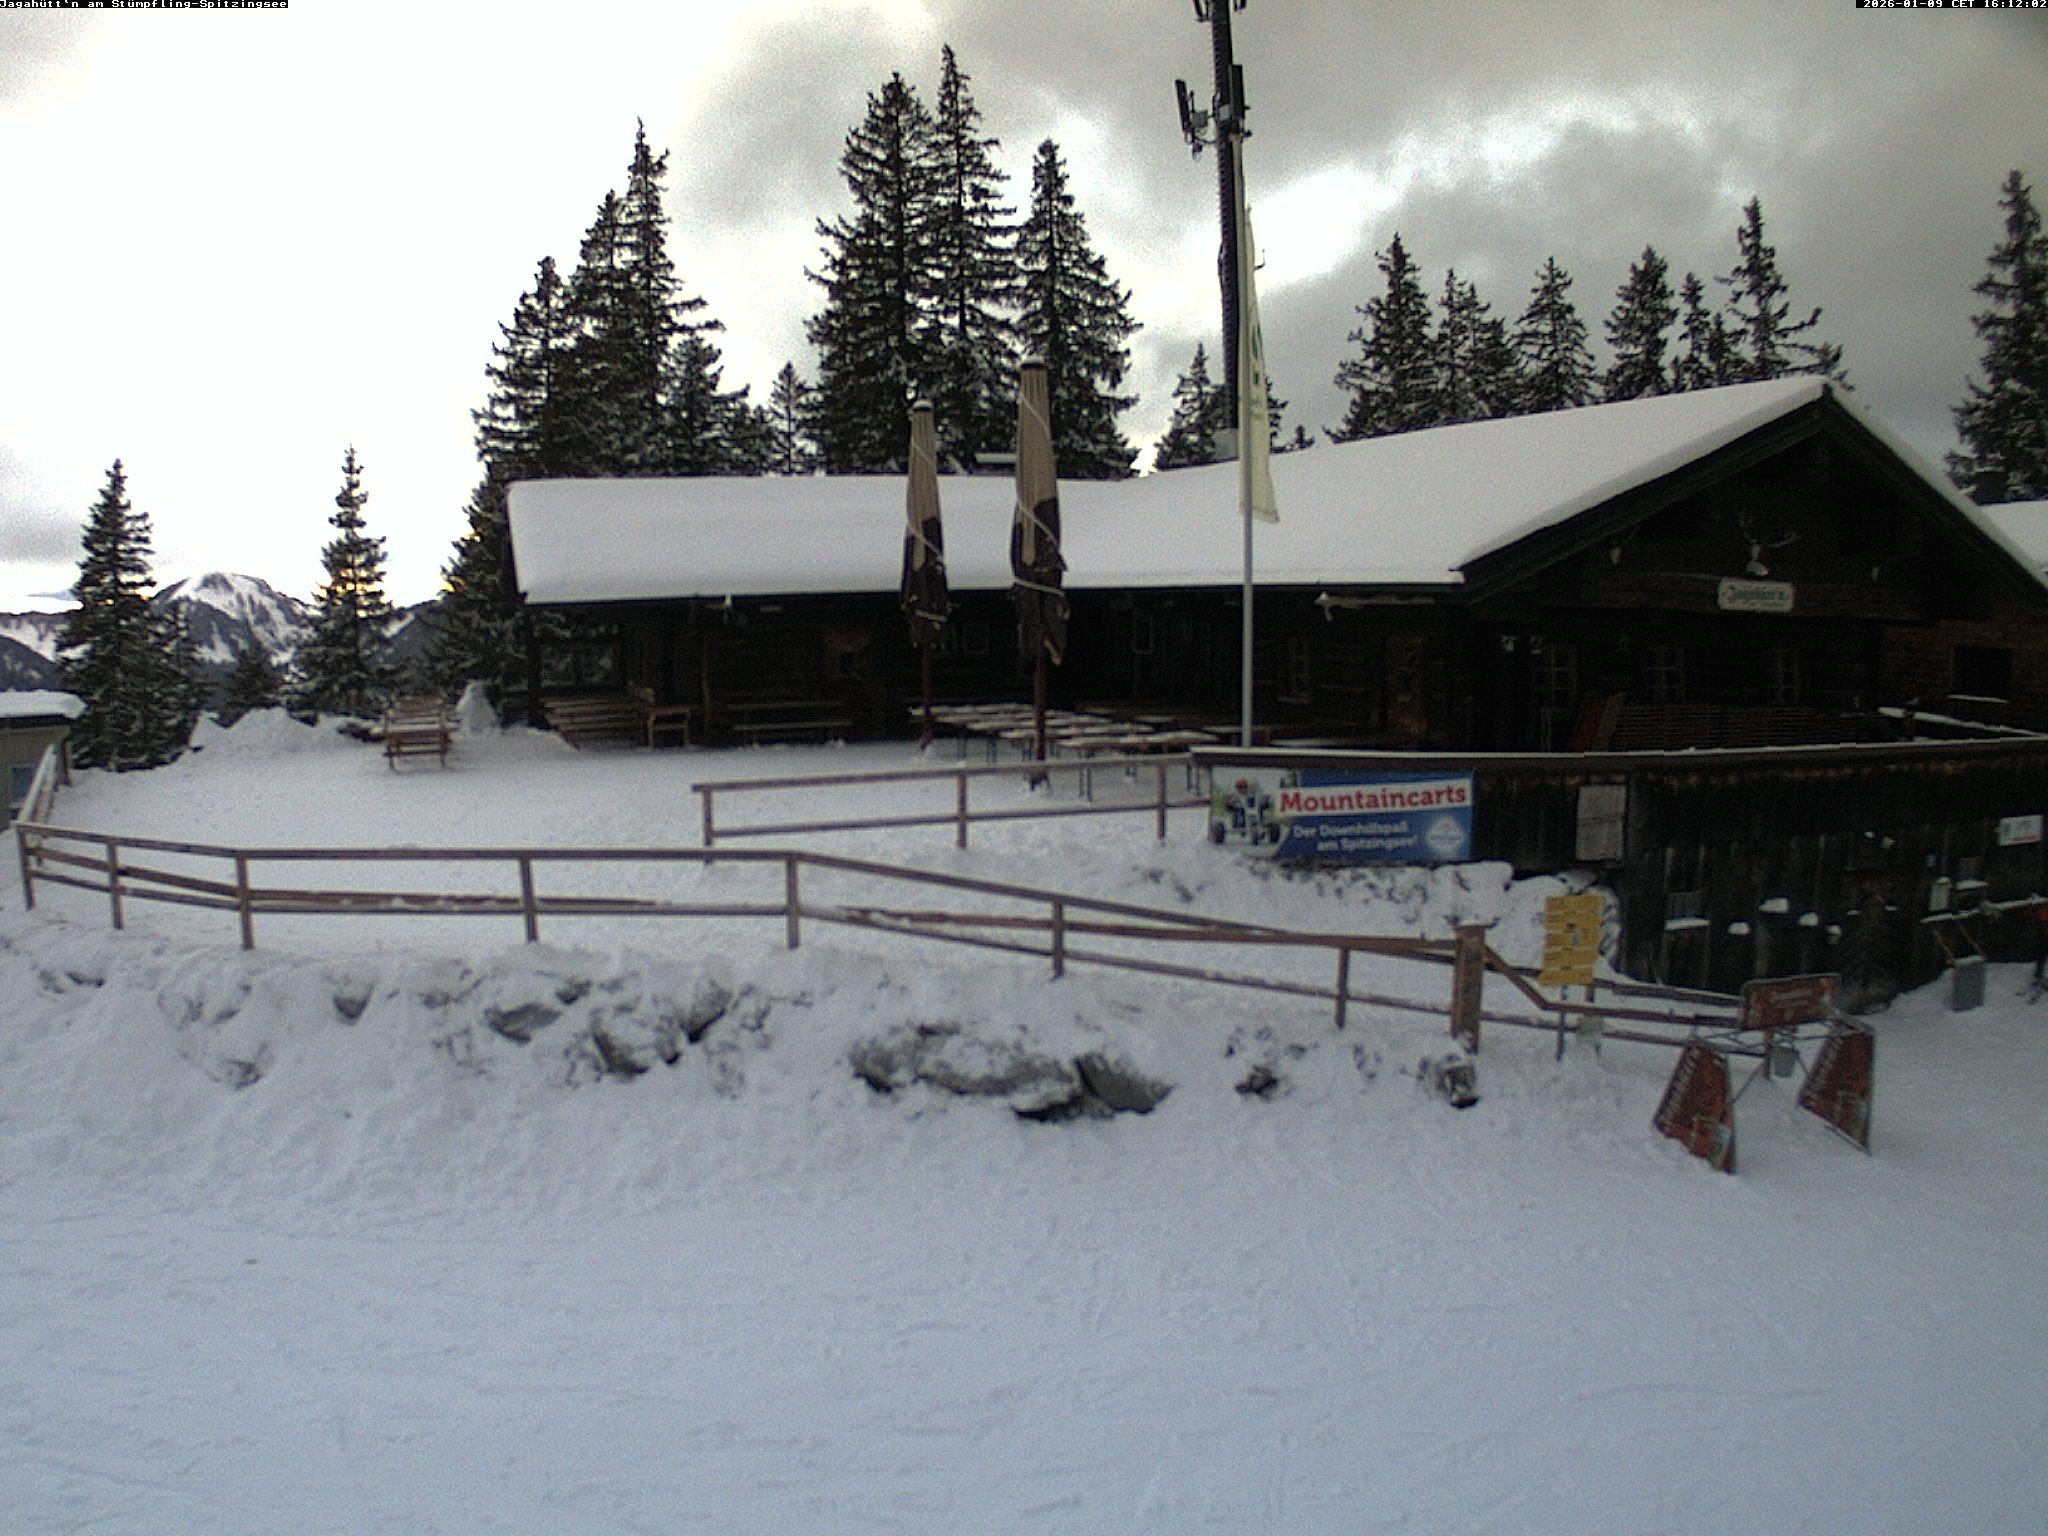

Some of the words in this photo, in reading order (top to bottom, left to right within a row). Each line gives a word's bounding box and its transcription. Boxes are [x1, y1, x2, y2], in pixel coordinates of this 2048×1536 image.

[1280, 785, 1467, 812] Mountaincarts
[1293, 824, 1316, 838] Der
[1317, 842, 1340, 852] am
